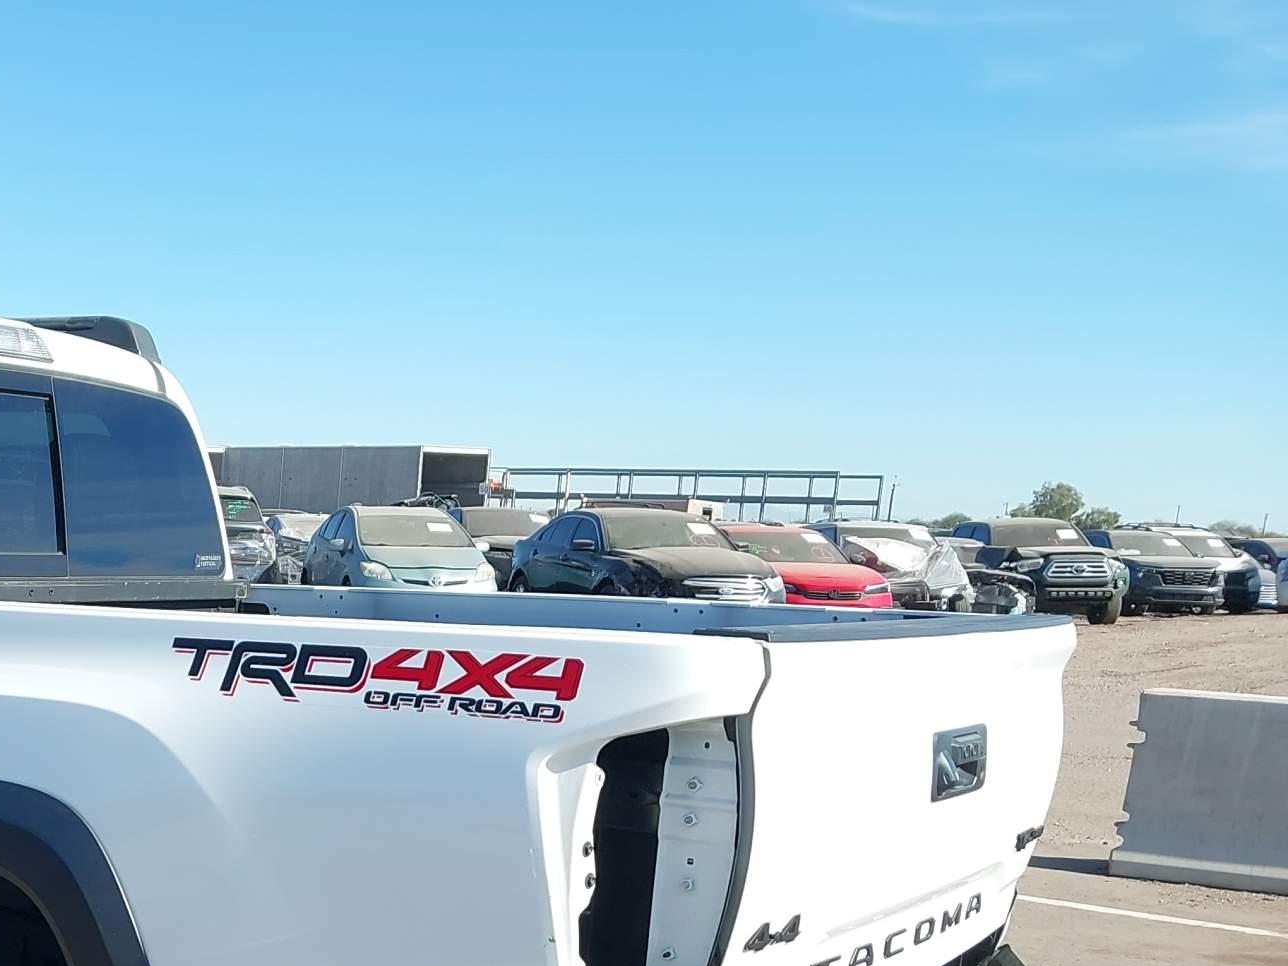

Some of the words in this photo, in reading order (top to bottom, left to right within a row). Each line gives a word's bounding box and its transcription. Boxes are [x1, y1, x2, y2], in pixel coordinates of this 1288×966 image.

[172, 636, 372, 703] TRD
[363, 689, 444, 713] OFF
[446, 694, 565, 724] ROAD
